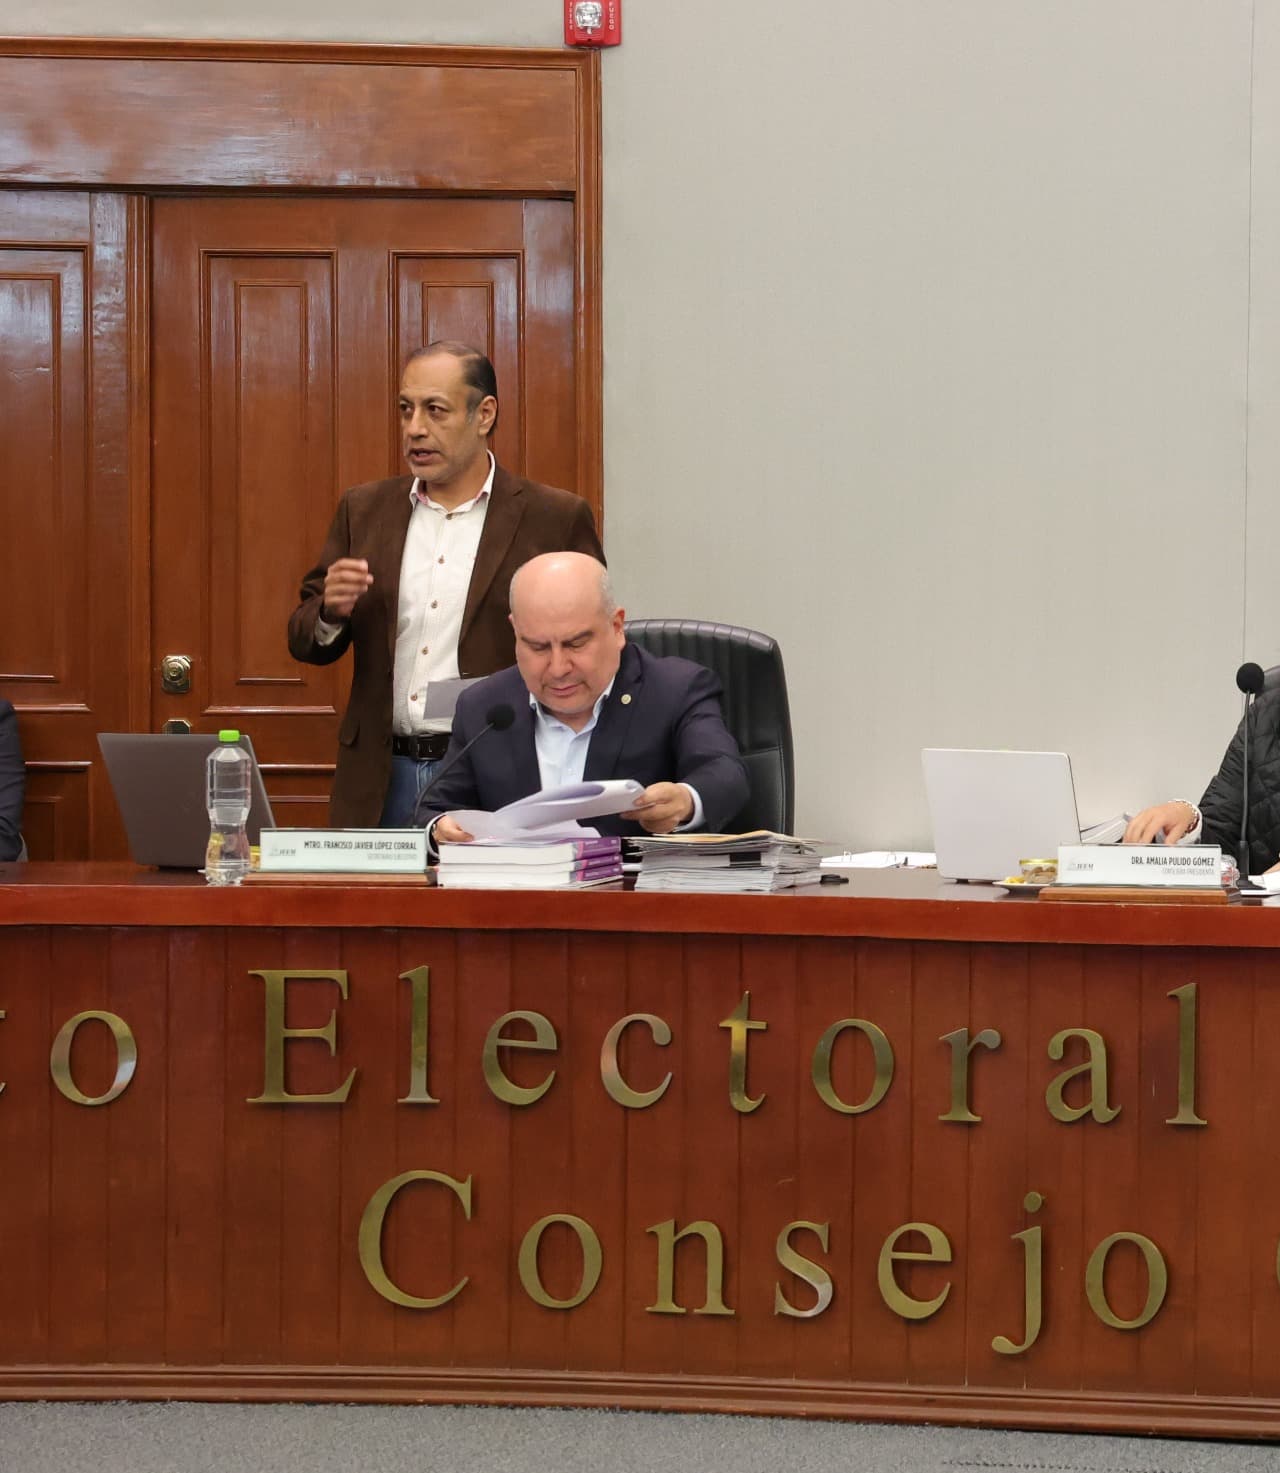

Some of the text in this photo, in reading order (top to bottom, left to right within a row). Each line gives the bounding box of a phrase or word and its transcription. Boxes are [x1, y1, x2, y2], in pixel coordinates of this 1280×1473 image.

[304, 841, 323, 849] MTRO.
[323, 841, 353, 850] FRANCISCO
[354, 841, 373, 850] JAVIER
[394, 841, 417, 850] CORRAL
[1131, 856, 1215, 867] DRA. AMALIA PULIDO GÓMEZ
[247, 965, 1208, 1126] Electoral
[358, 1169, 1168, 1356] Consejo
